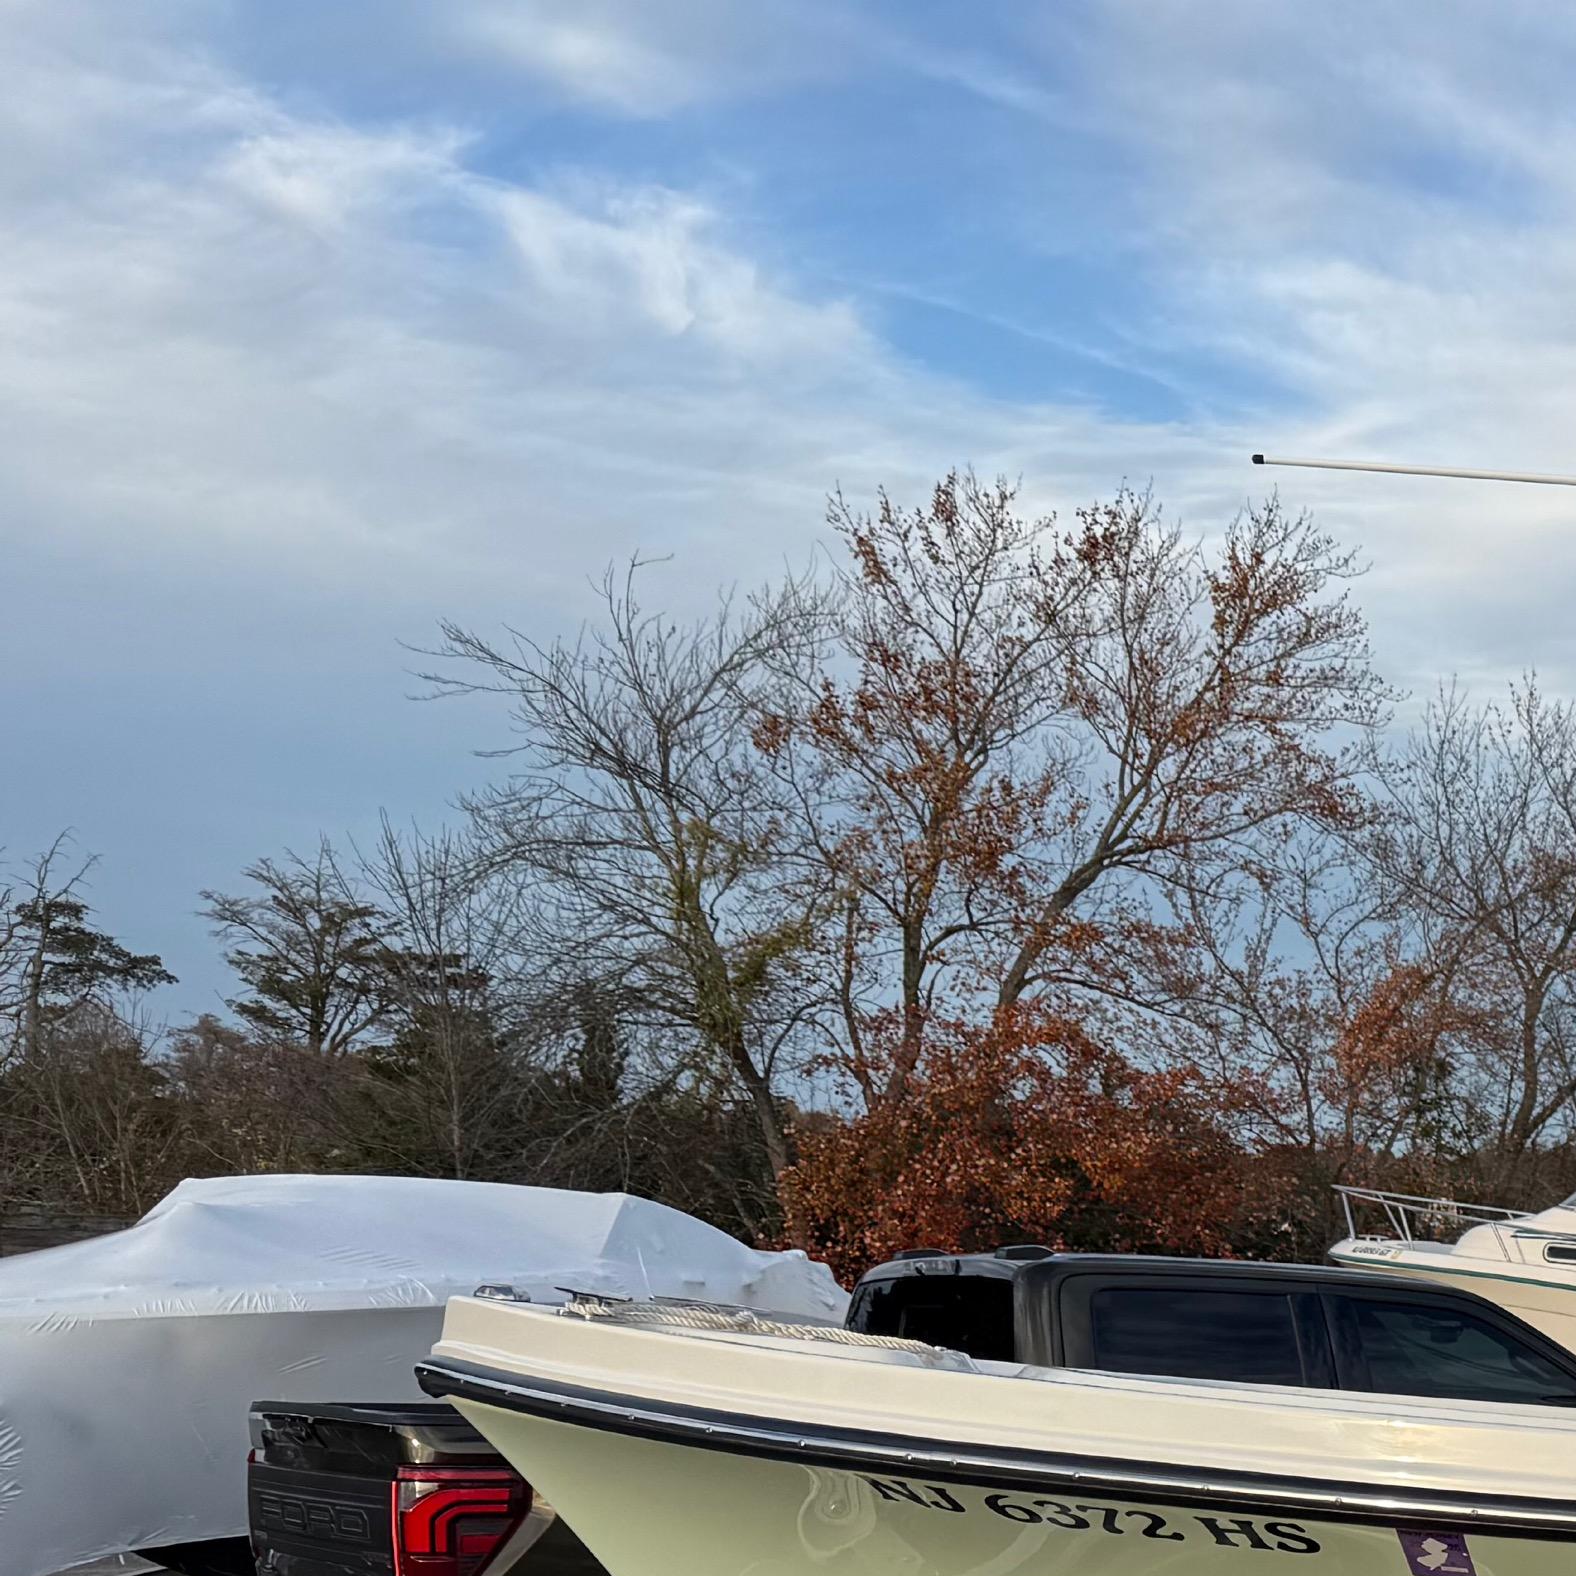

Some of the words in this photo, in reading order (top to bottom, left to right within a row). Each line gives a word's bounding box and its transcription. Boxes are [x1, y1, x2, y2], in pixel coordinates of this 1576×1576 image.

[259, 1495, 371, 1541] FORD
[864, 1477, 966, 1513] NJ
[984, 1494, 1185, 1541] 6372
[1193, 1515, 1321, 1554] HS
